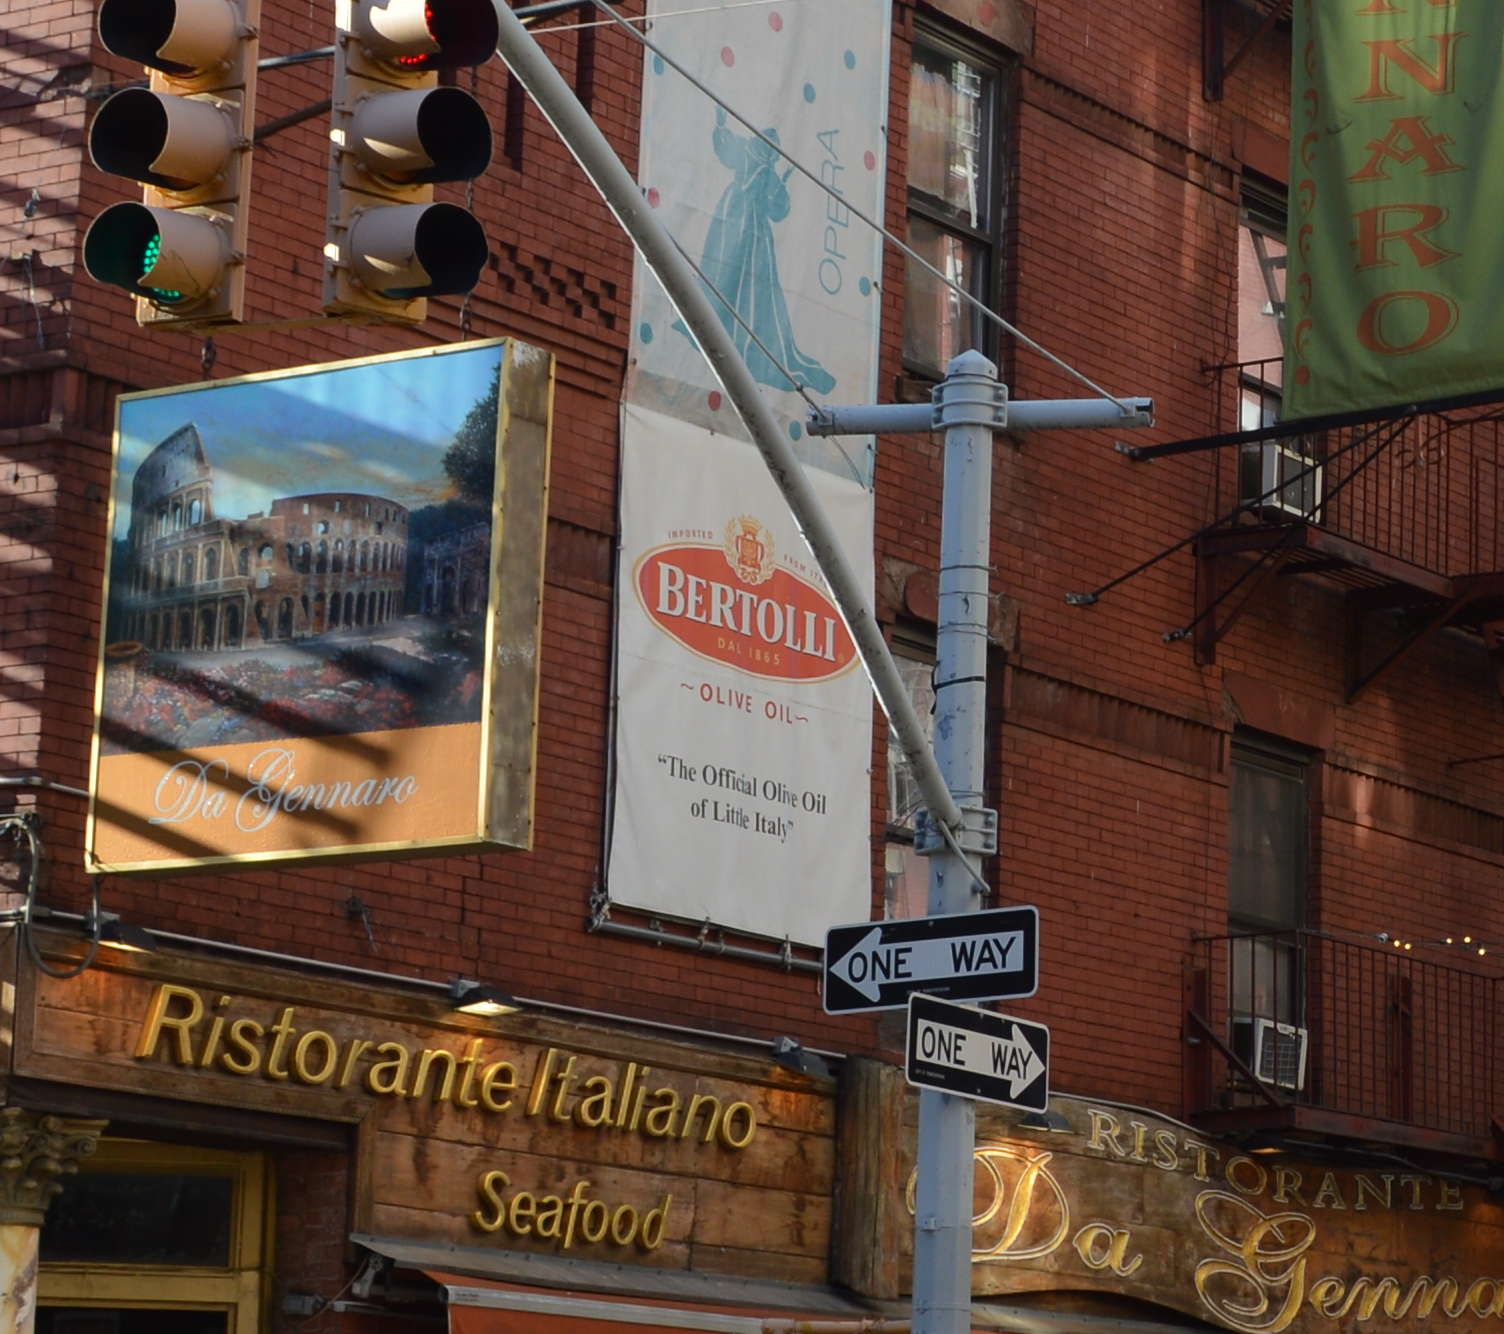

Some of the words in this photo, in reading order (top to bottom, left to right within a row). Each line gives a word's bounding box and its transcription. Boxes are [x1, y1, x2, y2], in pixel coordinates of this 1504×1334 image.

[815, 128, 850, 295] OPERA
[667, 529, 714, 541] IMPORTED
[783, 553, 807, 574] FROM
[655, 560, 837, 663] BERTOLLI
[717, 636, 743, 656] DAL
[748, 647, 781, 666] 1865
[699, 682, 753, 715] OLIVE
[764, 700, 794, 725] OIL
[147, 757, 230, 826] Da
[233, 746, 419, 833] Gennaro
[690, 796, 709, 819] of
[712, 799, 751, 832] Little
[702, 764, 758, 799] Official
[762, 778, 799, 809] Olive
[802, 790, 828, 816] Oil
[848, 946, 913, 984] ONE
[950, 936, 1017, 973] WAY
[135, 982, 519, 1113] Ristorante
[526, 1046, 758, 1149] Italiano
[921, 1025, 968, 1067] ONE
[991, 1040, 1034, 1081] WAY
[1086, 1107, 1466, 1212] RISTORANTE
[471, 1169, 674, 1251] Seafood
[906, 1146, 1145, 1277] Da
